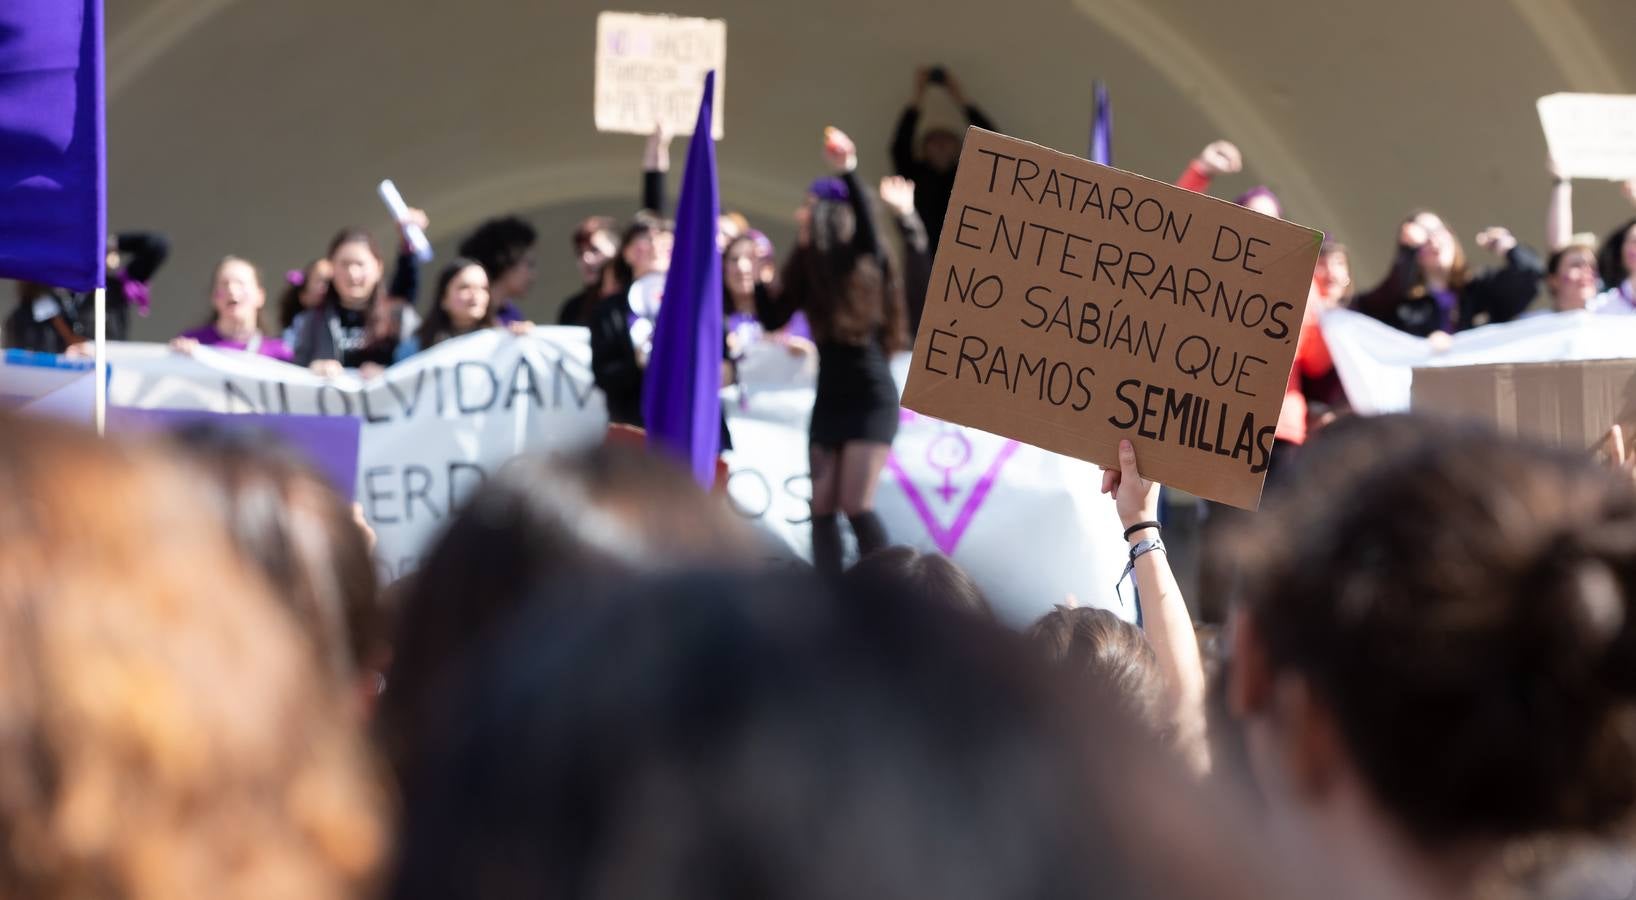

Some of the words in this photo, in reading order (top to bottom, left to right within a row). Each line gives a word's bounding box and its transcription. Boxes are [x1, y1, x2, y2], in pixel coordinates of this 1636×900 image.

[954, 204, 1294, 345] ENTERRARNOS,
[977, 148, 1193, 244] TRATARON
[1212, 224, 1272, 275] DE
[317, 356, 596, 424] OLVIDAM
[943, 264, 1004, 309] NO
[1020, 285, 1167, 364] SABÍAN
[1174, 334, 1269, 397] QUE
[925, 319, 1096, 412] ÉRAMOS
[1107, 378, 1277, 474] SEMILLAS
[365, 462, 489, 524] ERD
[727, 467, 812, 524] OS
